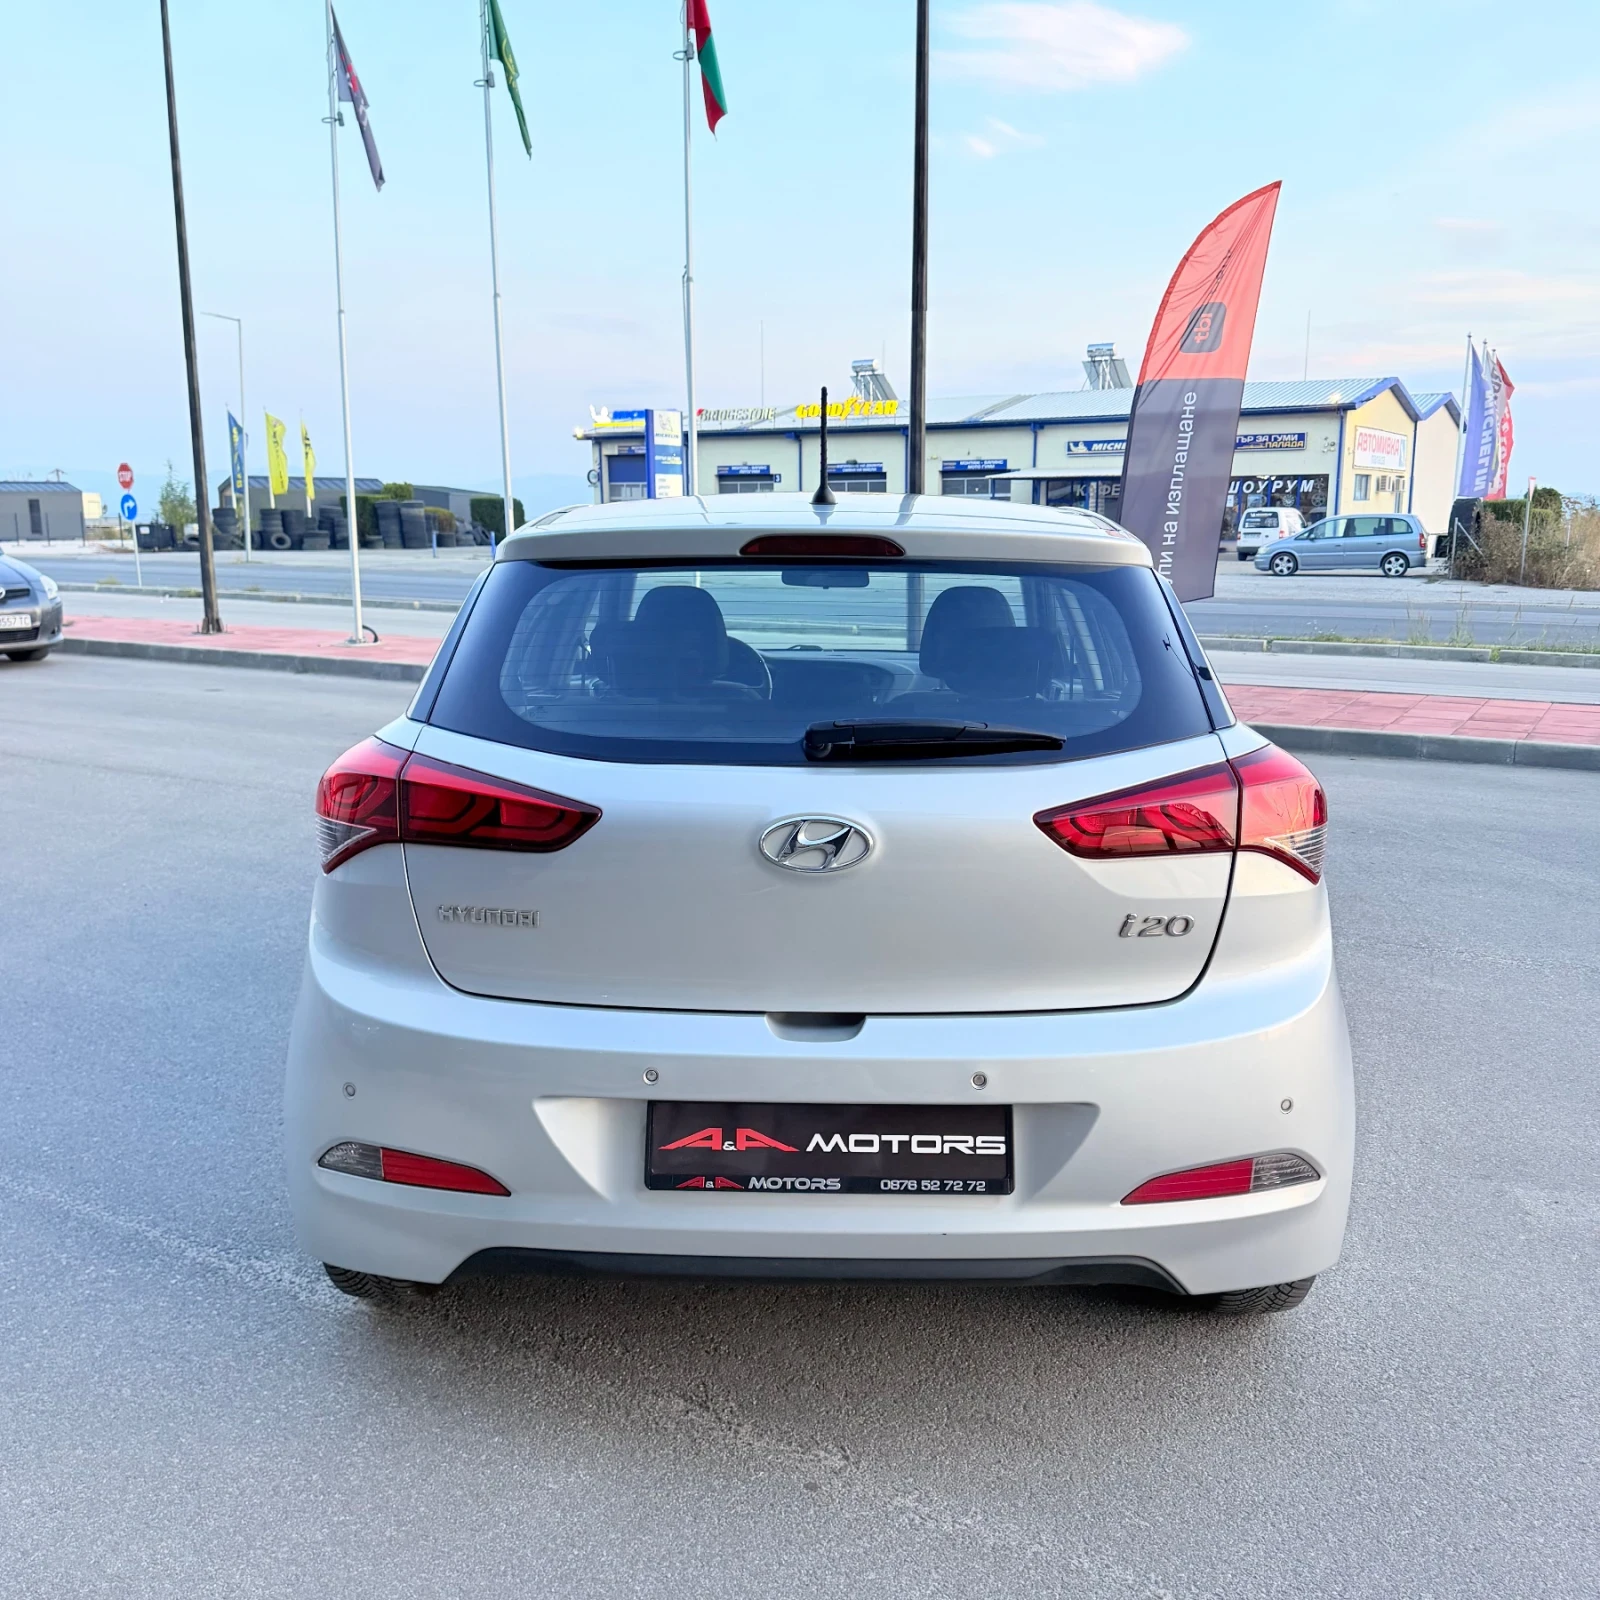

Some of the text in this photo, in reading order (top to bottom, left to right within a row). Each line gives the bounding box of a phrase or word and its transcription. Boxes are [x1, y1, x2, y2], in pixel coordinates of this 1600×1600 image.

[696, 408, 776, 421] BRIDGESTONE
[1256, 435, 1269, 443] ЗА
[1271, 434, 1299, 442] ГУМИ
[1265, 441, 1305, 449] ПАЛАДА
[1165, 390, 1197, 516] изплащане
[1162, 520, 1179, 546] на
[0, 616, 17, 627] 557
[438, 905, 540, 928] HYUNDAI
[1119, 913, 1196, 938] i20
[658, 1127, 1006, 1156] A&A MOTORS
[675, 1176, 987, 1192] A&A MOTORS 0876 52 72 72
